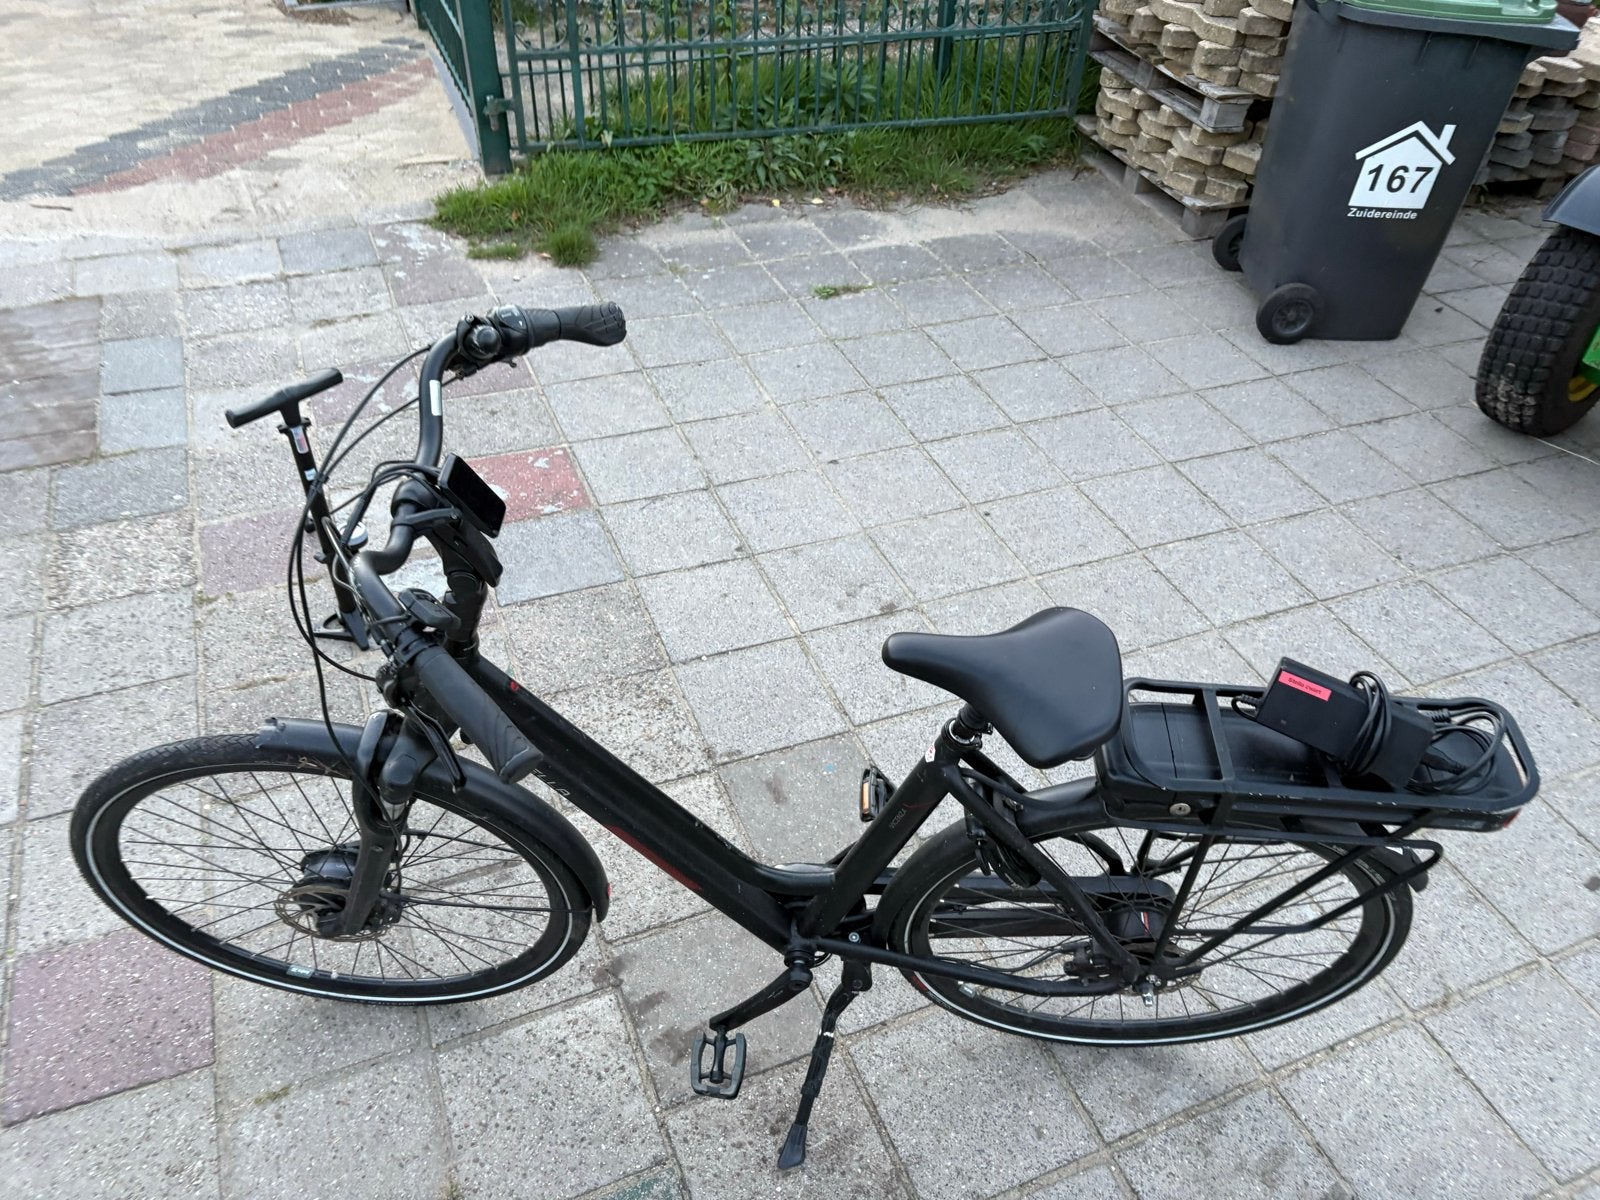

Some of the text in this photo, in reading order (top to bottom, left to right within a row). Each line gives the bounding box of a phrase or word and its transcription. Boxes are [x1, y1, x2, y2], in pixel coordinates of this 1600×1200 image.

[1367, 164, 1434, 193] 167
[1347, 208, 1418, 220] Zuidereinde
[532, 768, 571, 796] ELLA
